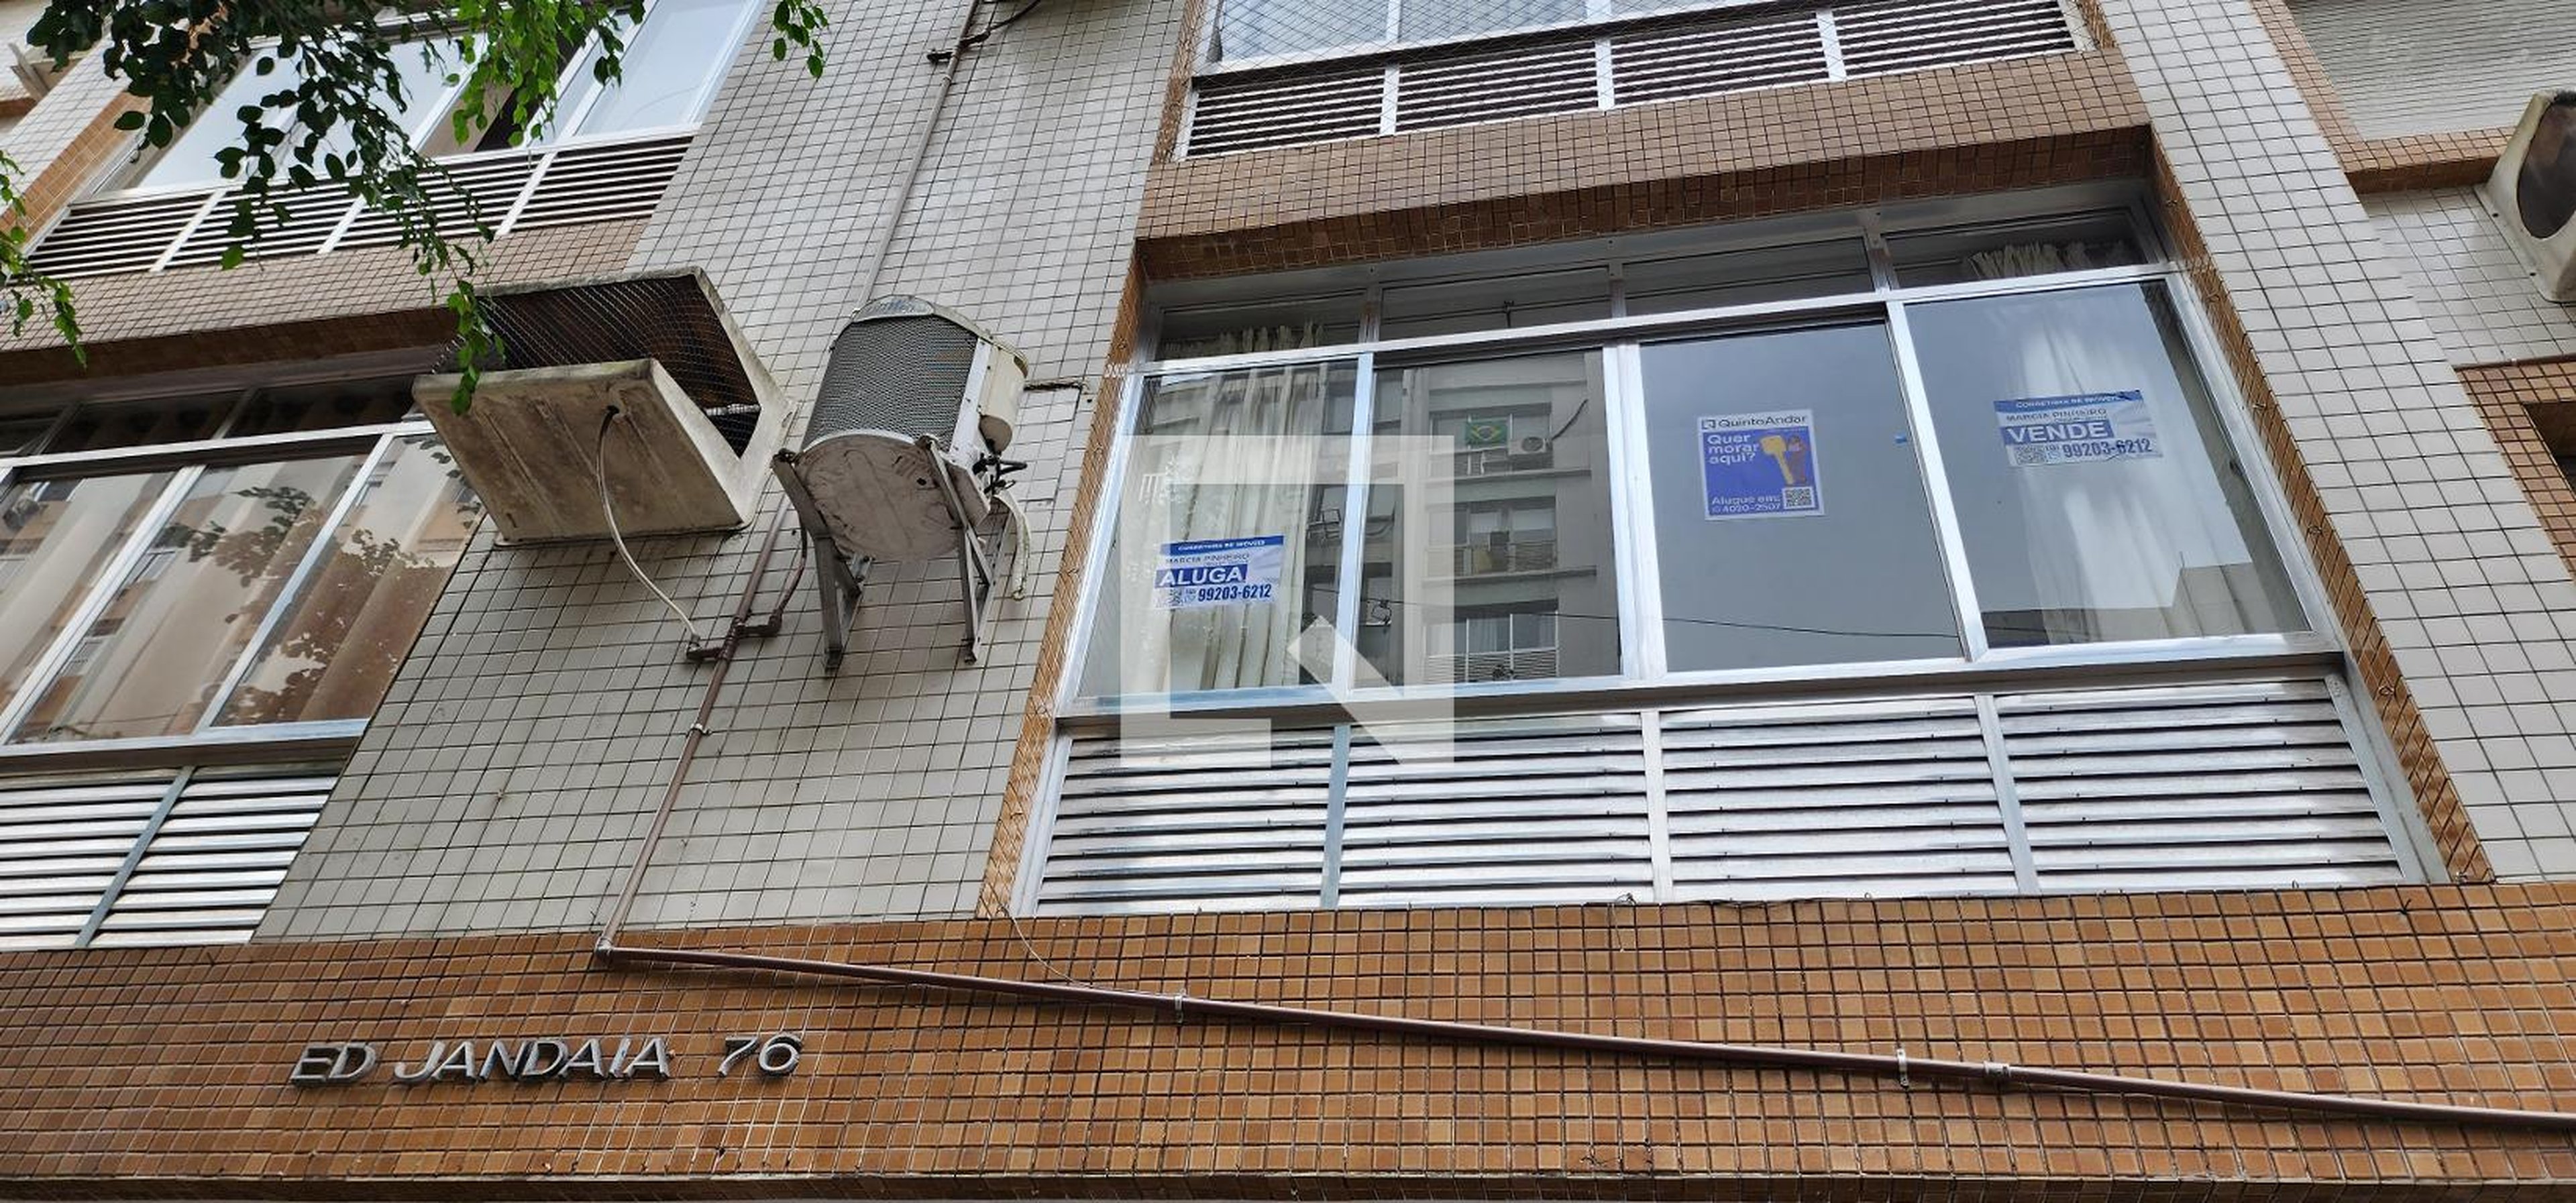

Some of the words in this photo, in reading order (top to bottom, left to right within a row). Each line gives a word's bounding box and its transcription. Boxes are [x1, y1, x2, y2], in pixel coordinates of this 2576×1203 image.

[1718, 415, 1807, 428] QuintoAndar
[1707, 434, 1752, 445] Quer
[2006, 421, 2109, 443] VENDE
[1708, 442, 1759, 454] morar
[2062, 438, 2153, 458] 99203-6212
[1708, 452, 1756, 465] aqui?
[1711, 496, 1756, 506] Alugue
[1160, 566, 1243, 587] ALUGA
[1197, 583, 1272, 602] 99203-6212
[290, 1041, 377, 1086] ED
[394, 1035, 672, 1084] JANDAIA
[717, 1031, 804, 1078] 76
